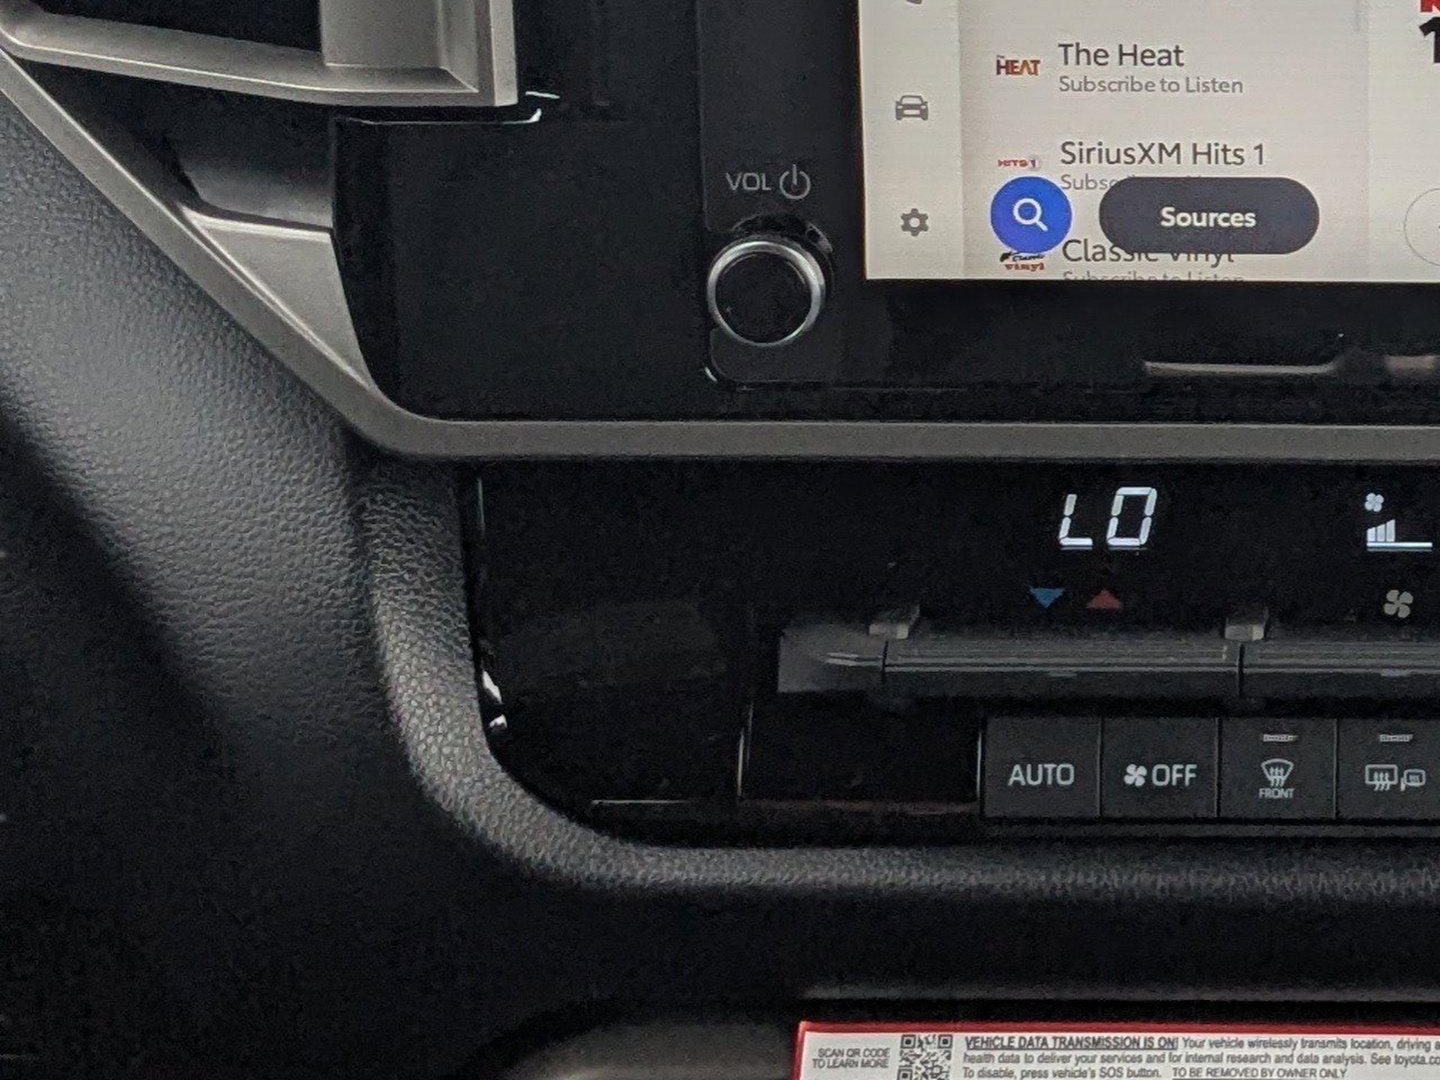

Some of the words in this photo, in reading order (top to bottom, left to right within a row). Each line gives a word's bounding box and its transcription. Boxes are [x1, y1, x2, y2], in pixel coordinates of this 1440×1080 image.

[1058, 43, 1109, 67] The
[1118, 43, 1185, 67] Heat
[996, 59, 1041, 75] HEAT
[1059, 76, 1157, 93] Subscribe
[1162, 79, 1182, 93] to
[1187, 77, 1245, 94] Listen
[1060, 141, 1182, 165] SiriusXM
[1191, 142, 1245, 166] Hits
[1253, 143, 1266, 166] 1
[726, 172, 772, 191] VOL
[1161, 206, 1257, 227] Sources
[1058, 486, 1158, 548] LO
[1008, 763, 1075, 787] AUTO
[1151, 764, 1197, 787] OFF
[1258, 788, 1294, 800] FRONT
[818, 1048, 845, 1058] SCAN
[846, 1048, 861, 1058] QR
[862, 1048, 890, 1058] CODE
[965, 1036, 1015, 1049] VEHICLE
[1018, 1036, 1049, 1049] DATA
[1052, 1036, 1140, 1049] TRANSMISSION
[1144, 1037, 1155, 1049] IS
[1158, 1037, 1178, 1049] ON!
[1182, 1037, 1206, 1049] Your
[1209, 1037, 1245, 1049] vehicle
[1248, 1037, 1297, 1051] wirelessly
[1301, 1037, 1347, 1050] transmits
[1350, 1038, 1393, 1051] location,
[1396, 1038, 1431, 1052] driving
[812, 1058, 826, 1068] TO
[826, 1058, 859, 1068] LEARN
[861, 1058, 889, 1068] MORE
[963, 1052, 995, 1063] health
[998, 1052, 1020, 1063] data
[1024, 1053, 1034, 1063] to
[1037, 1052, 1071, 1063] deliver
[1075, 1054, 1097, 1066] your
[1100, 1052, 1143, 1063] services
[1145, 1052, 1166, 1063] and
[1168, 1052, 1183, 1063] for
[1185, 1052, 1224, 1063] internal
[1226, 1052, 1272, 1064] research
[1274, 1053, 1295, 1064] and
[1297, 1053, 1320, 1064] data
[1323, 1052, 1367, 1066] analysis.
[1370, 1053, 1391, 1065] See
[963, 1067, 975, 1078] To
[977, 1067, 1017, 1079] disable,
[1020, 1070, 1049, 1080] press
[1052, 1067, 1096, 1078] vehicle's
[1099, 1067, 1123, 1078] SOS
[1126, 1067, 1162, 1078] button.
[1172, 1067, 1187, 1078] TO
[1189, 1067, 1201, 1078] BE
[1206, 1067, 1258, 1078] REMOVED
[1260, 1067, 1274, 1078] BY
[1276, 1068, 1317, 1078] OWNER
[1319, 1068, 1348, 1078] ONLY
